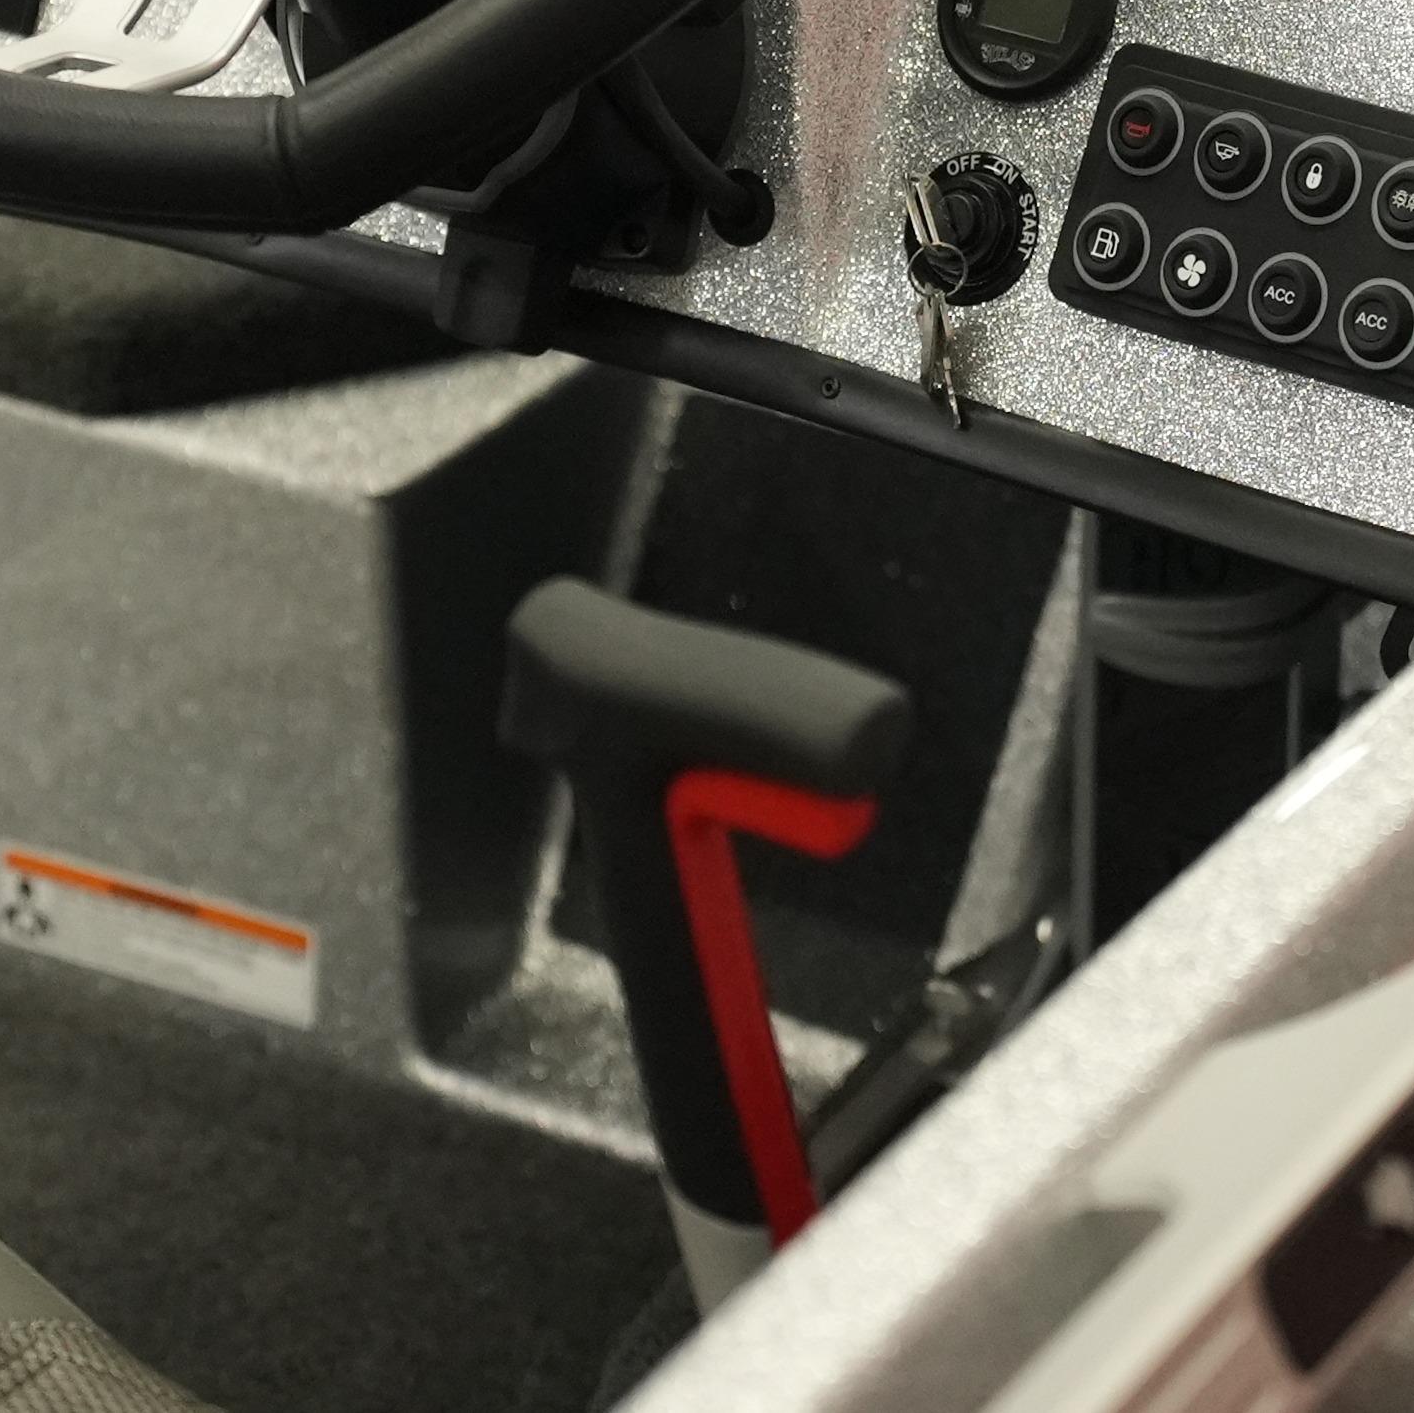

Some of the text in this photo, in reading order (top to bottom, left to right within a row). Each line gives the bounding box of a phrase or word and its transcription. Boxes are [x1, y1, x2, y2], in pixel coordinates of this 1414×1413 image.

[946, 154, 1037, 262] OFF ON START
[1263, 285, 1296, 305] ACC
[1354, 311, 1388, 331] ACC
